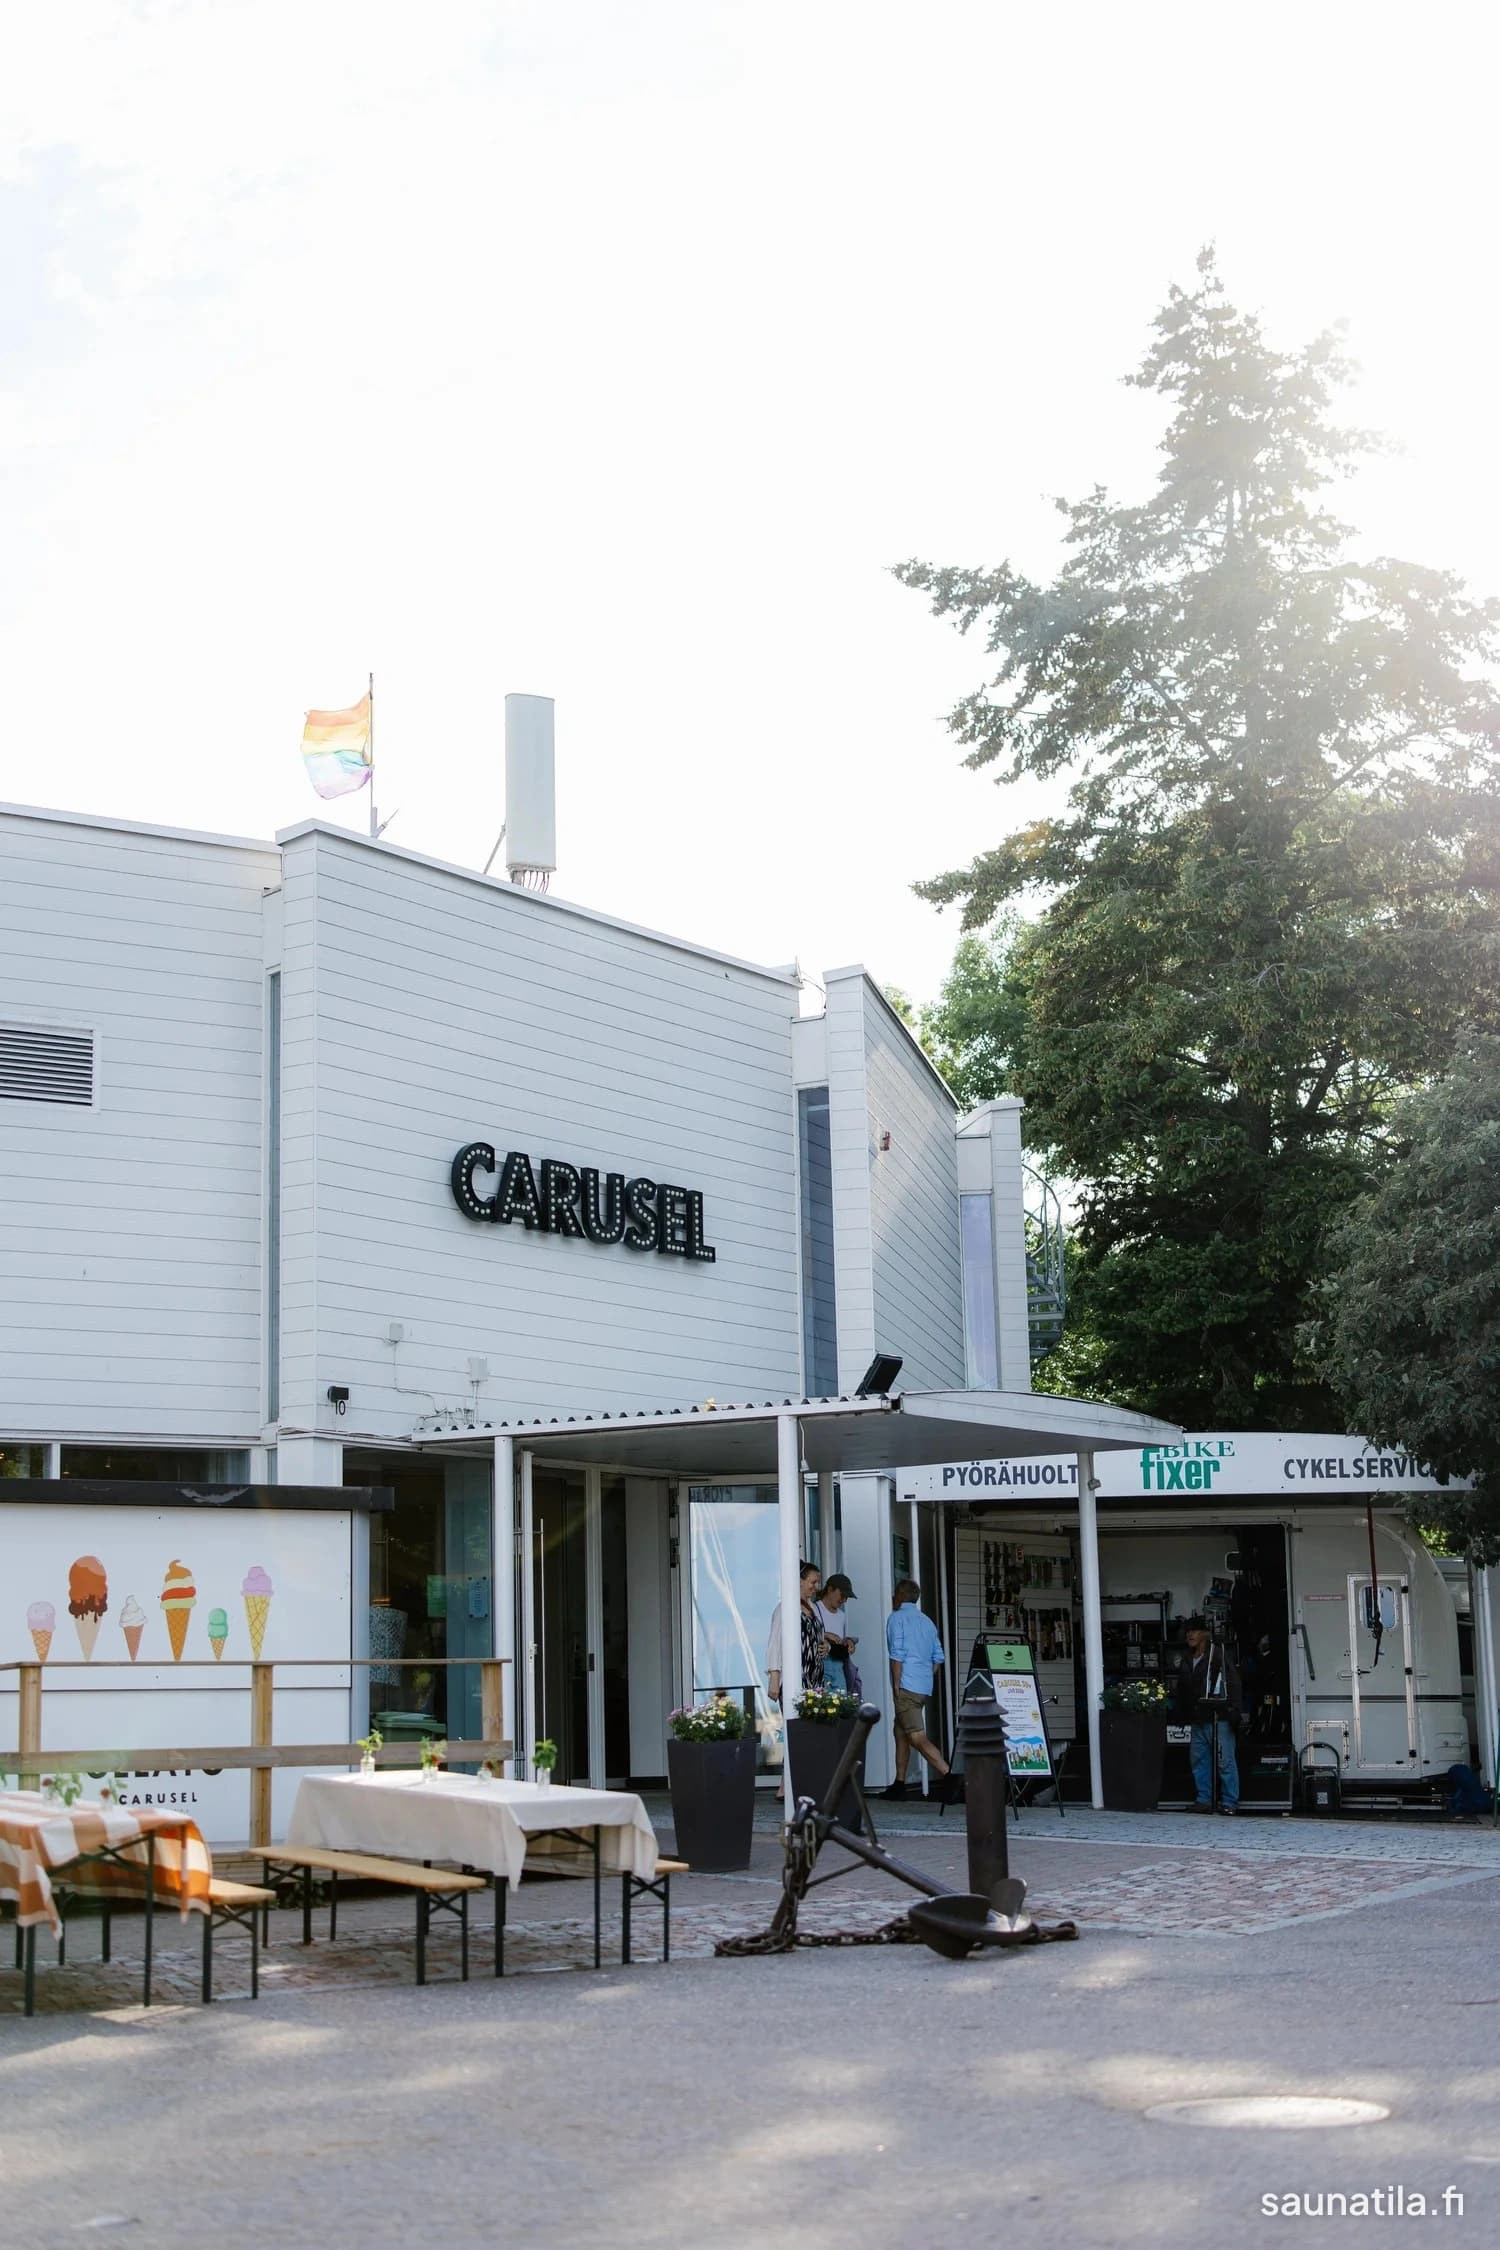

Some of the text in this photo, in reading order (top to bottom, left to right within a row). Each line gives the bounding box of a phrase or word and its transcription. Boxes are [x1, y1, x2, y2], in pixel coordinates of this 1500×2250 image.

[452, 1142, 716, 1263] CARUSEL
[1163, 1441, 1235, 1458] BIKE
[942, 1461, 1079, 1487] PYÖRÄHUOLT
[1140, 1447, 1220, 1490] fixer
[1283, 1457, 1438, 1480] CYKELSERVIC
[118, 1791, 198, 1805] CARUSEL
